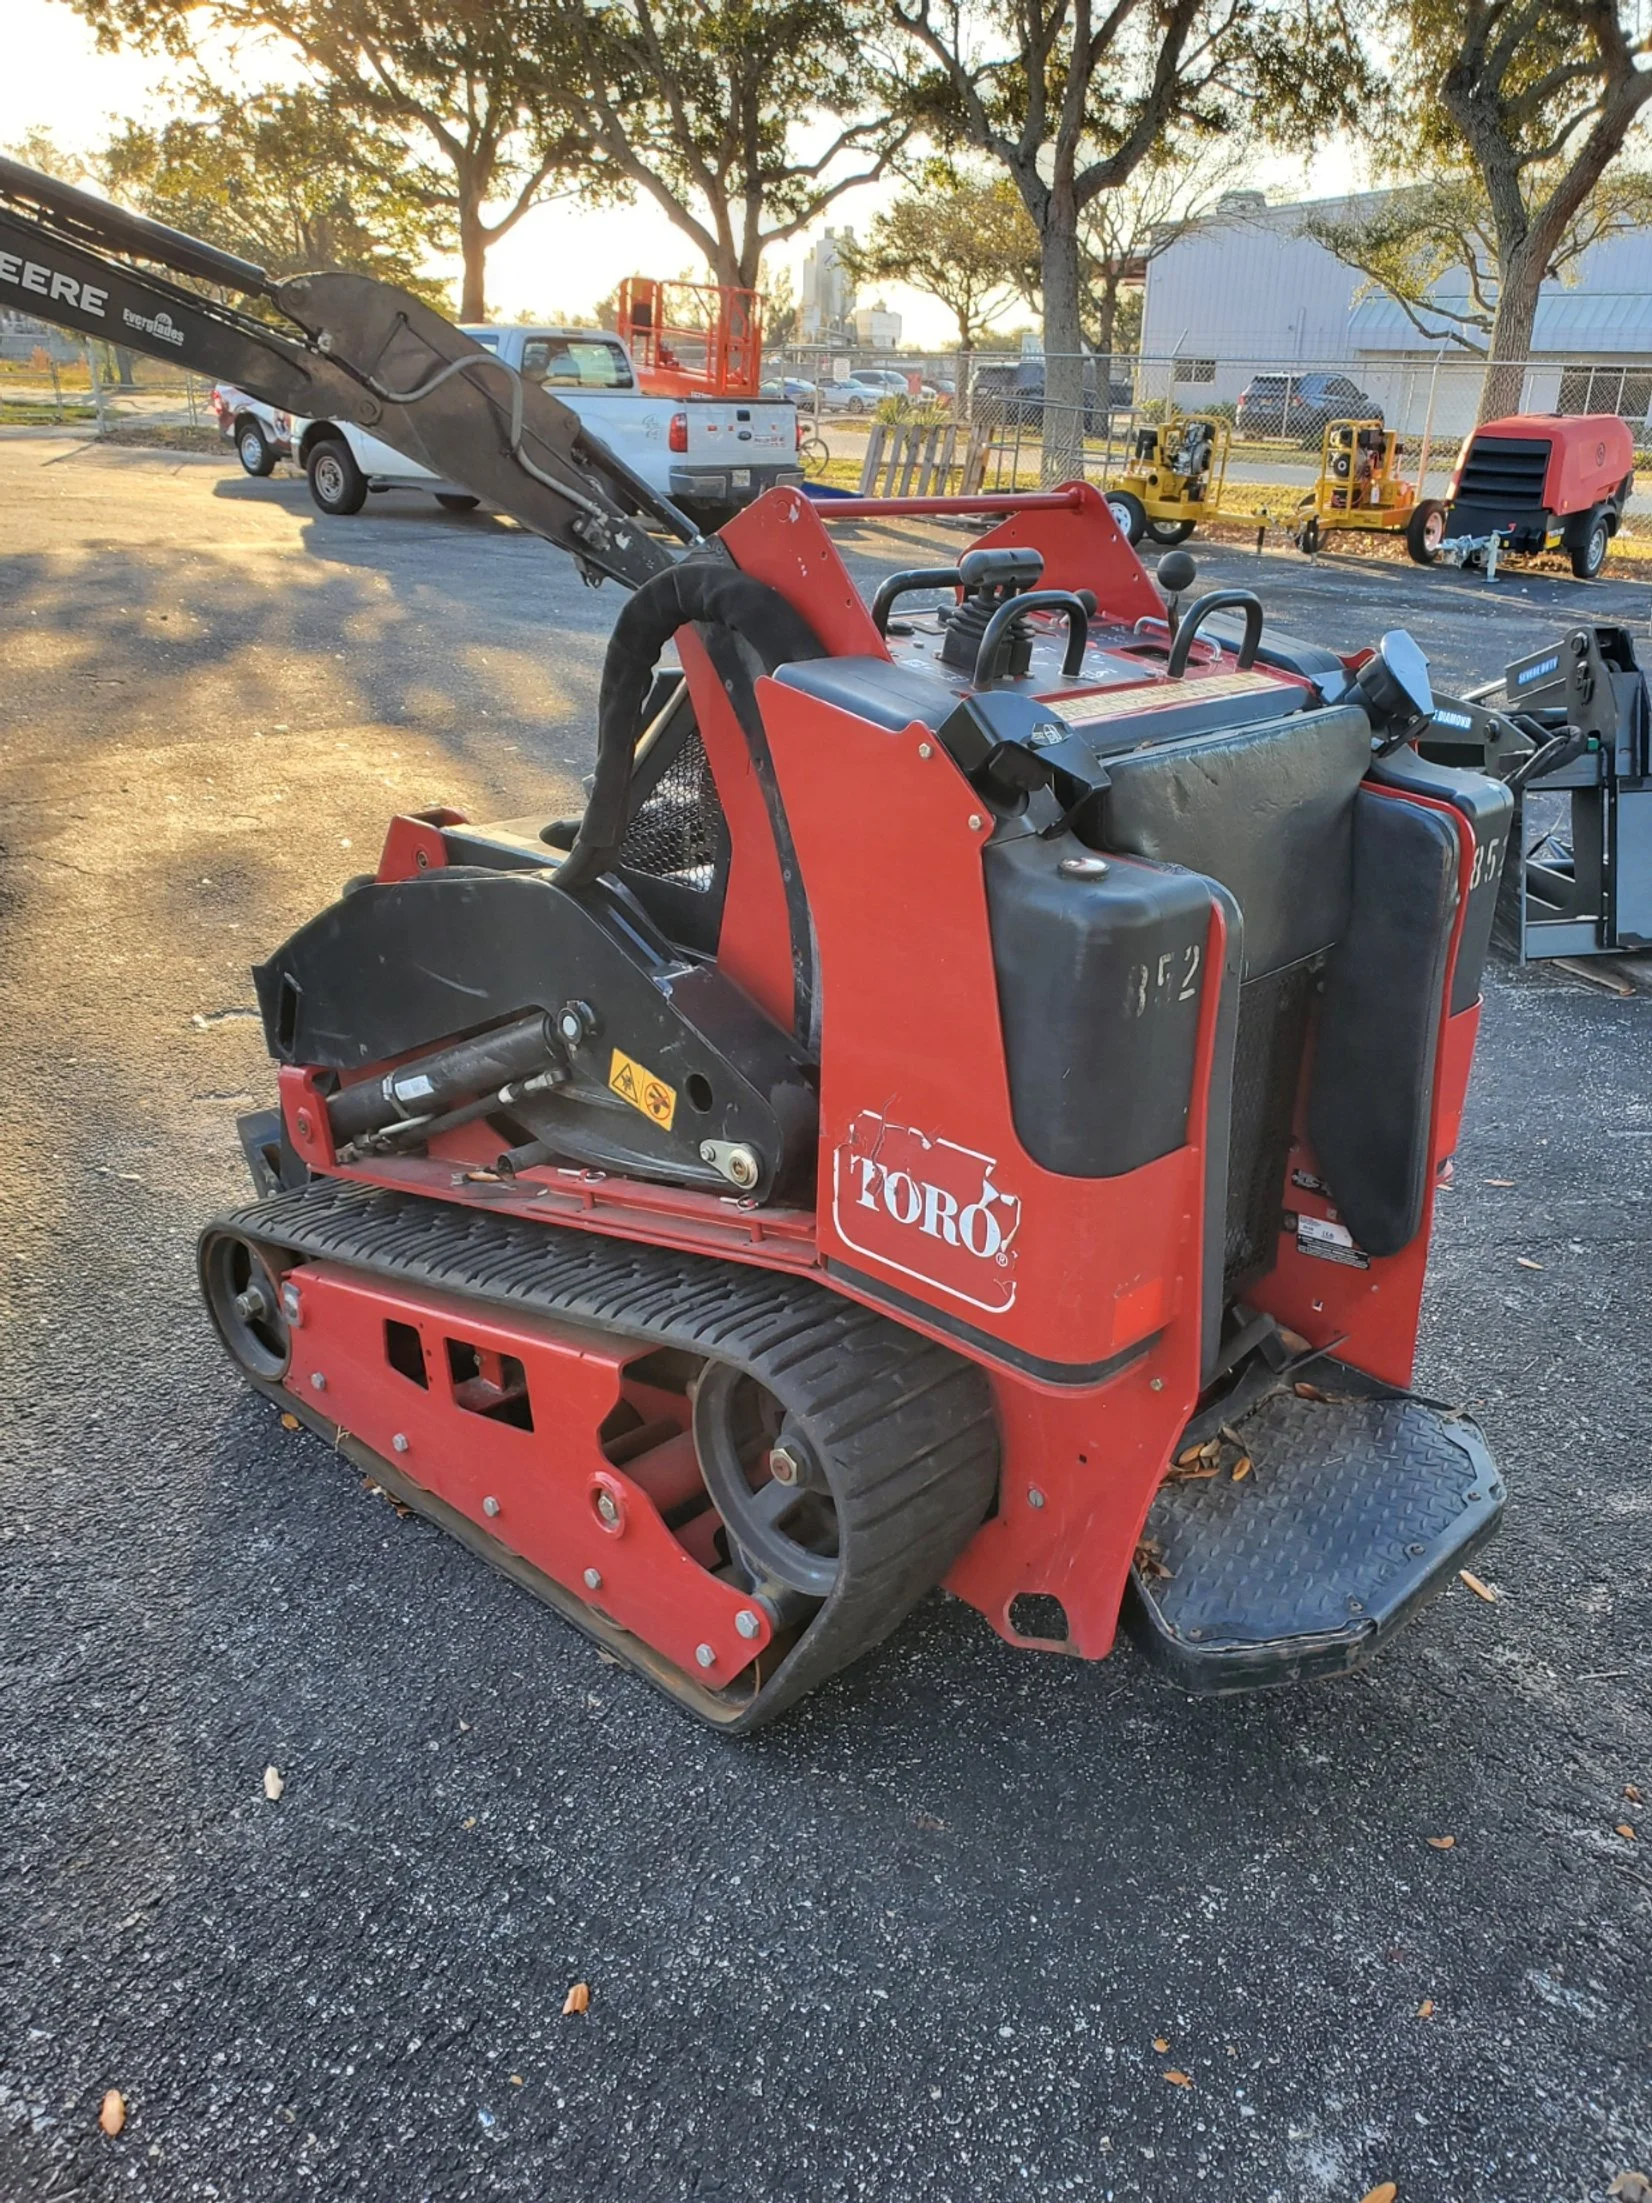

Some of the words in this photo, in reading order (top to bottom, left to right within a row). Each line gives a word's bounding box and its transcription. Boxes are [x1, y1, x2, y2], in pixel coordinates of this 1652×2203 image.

[122, 307, 185, 343] Everglades
[1437, 710, 1472, 729] DIAMOND
[850, 1153, 1002, 1258] TORO
